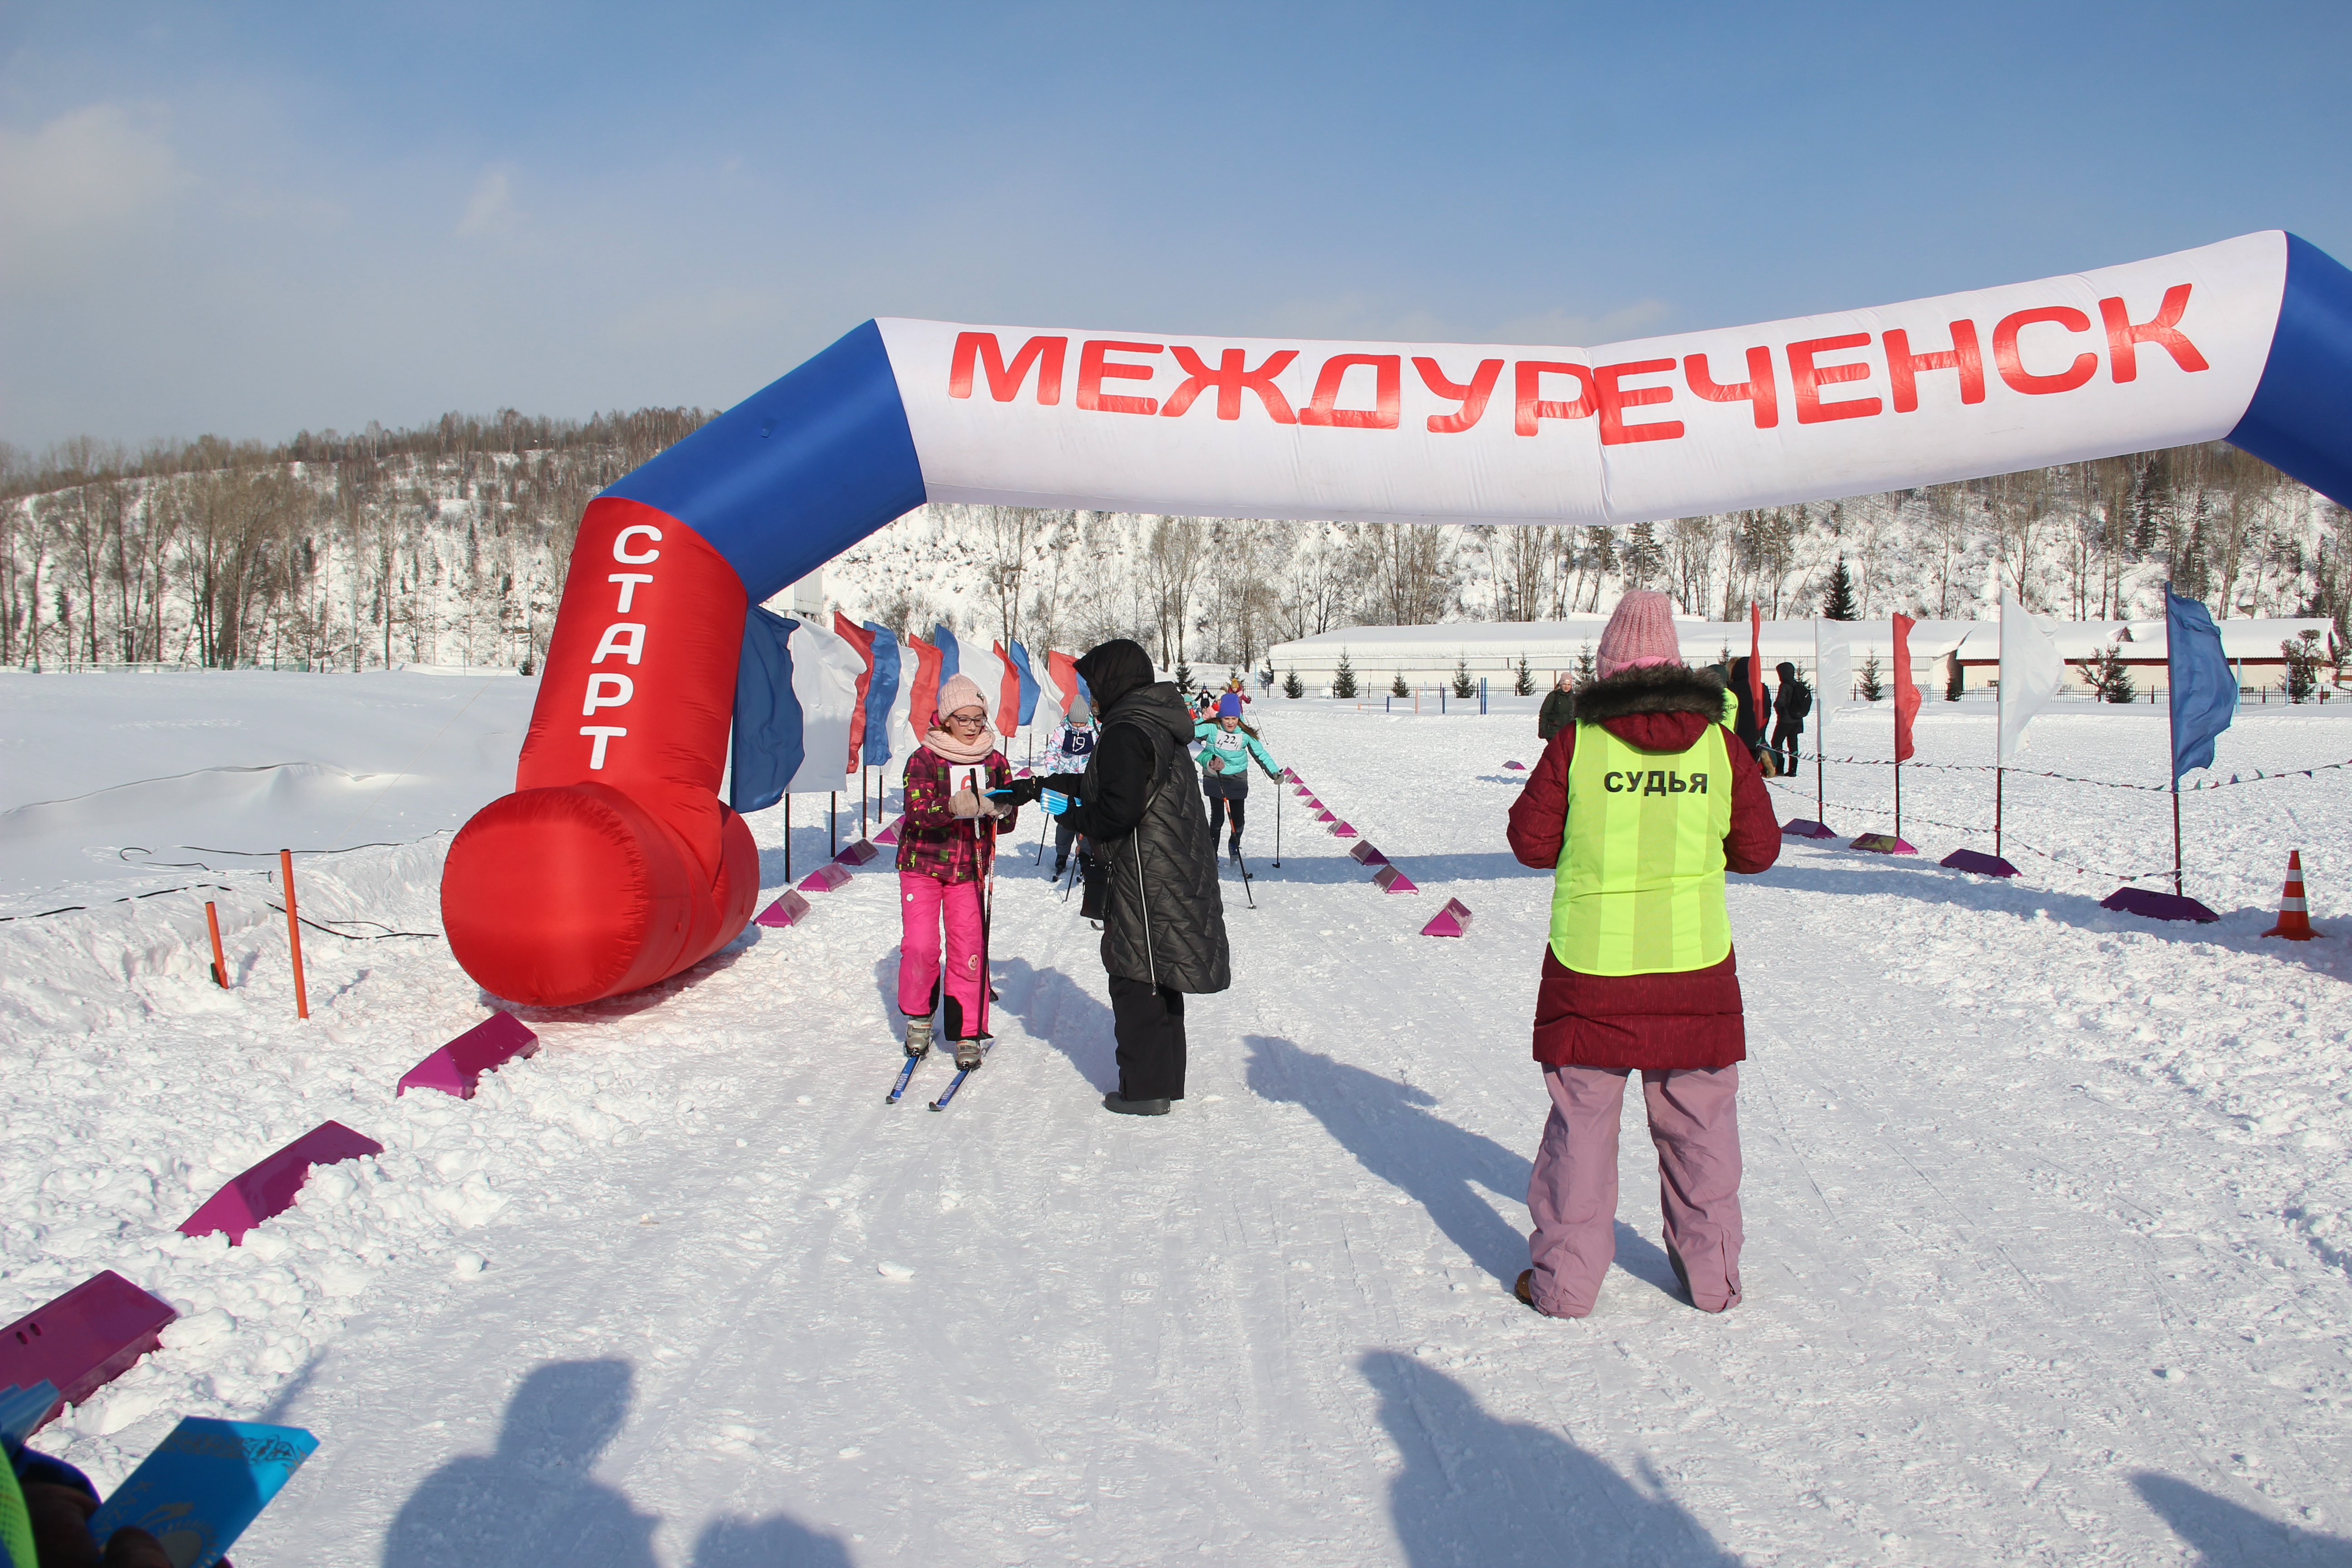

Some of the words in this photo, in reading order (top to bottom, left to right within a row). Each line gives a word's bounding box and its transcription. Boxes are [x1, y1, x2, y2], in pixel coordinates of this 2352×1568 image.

[949, 284, 2209, 446] МЕЖДУРЕЧЕНСК
[579, 524, 663, 769] СТАРТ
[1072, 736, 1086, 752] 19
[1223, 735, 1236, 744] 22
[1604, 771, 1708, 796] СУДЬЯ
